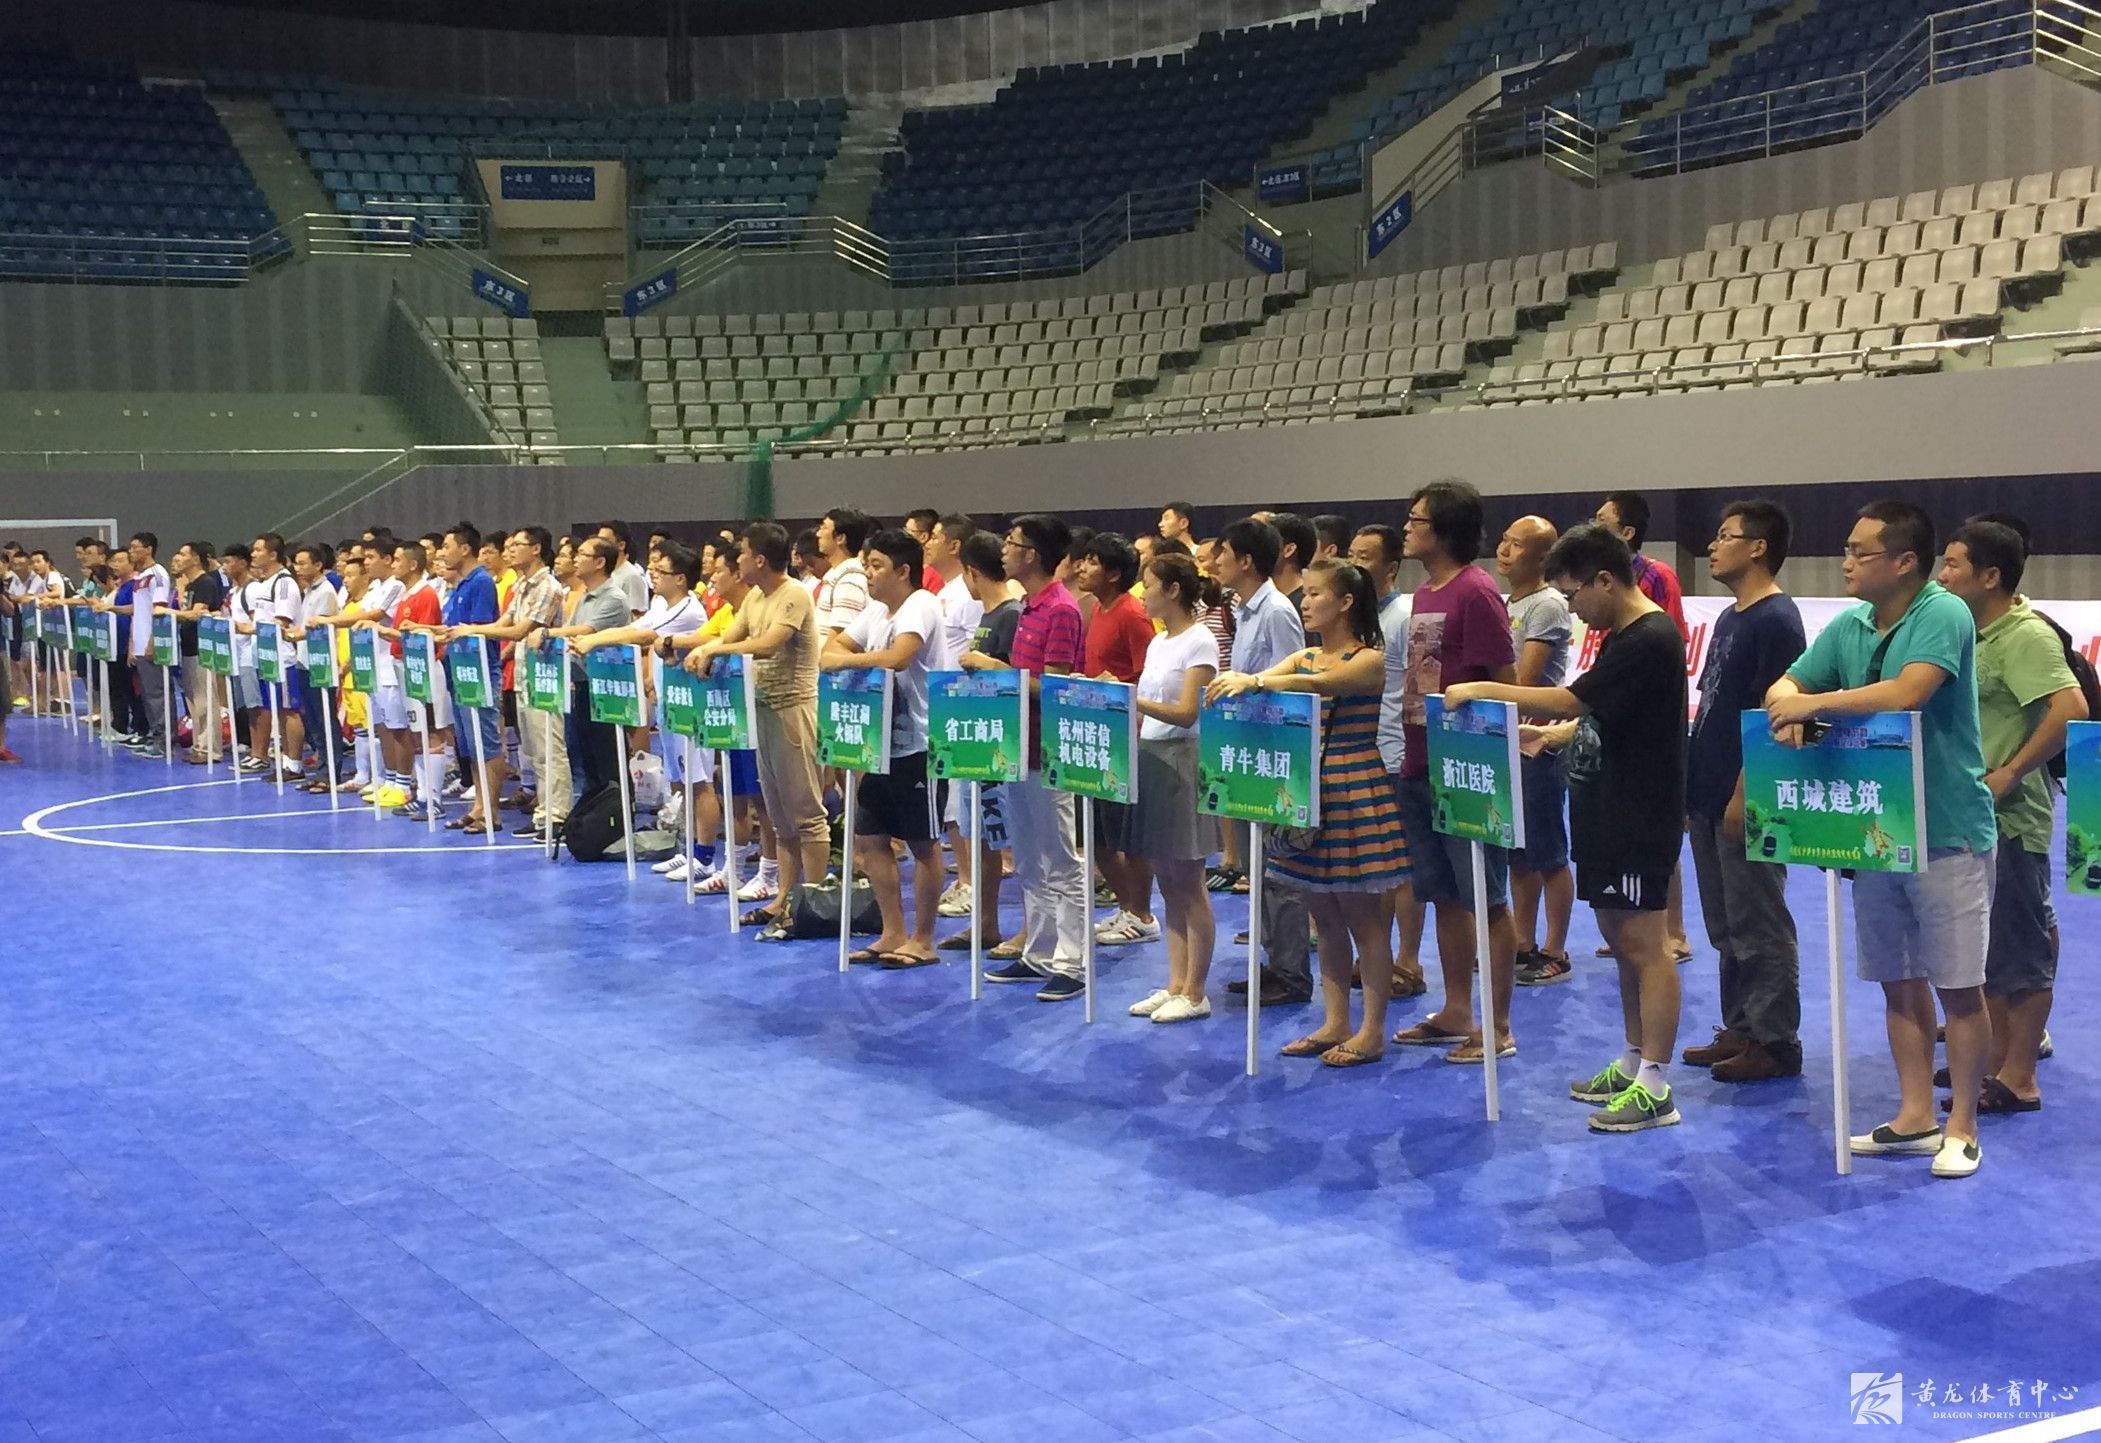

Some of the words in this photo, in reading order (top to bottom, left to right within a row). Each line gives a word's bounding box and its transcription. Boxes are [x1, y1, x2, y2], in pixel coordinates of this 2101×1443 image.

[704, 707, 737, 727] 公安分局
[945, 717, 1004, 742] 省工商局
[1058, 717, 1111, 748] 杭州诺信
[1058, 740, 1112, 771] 机电设备
[1219, 744, 1292, 780] 青牛集团
[1442, 757, 1497, 795] 浙江医院
[1774, 778, 1884, 815] 西城建筑
